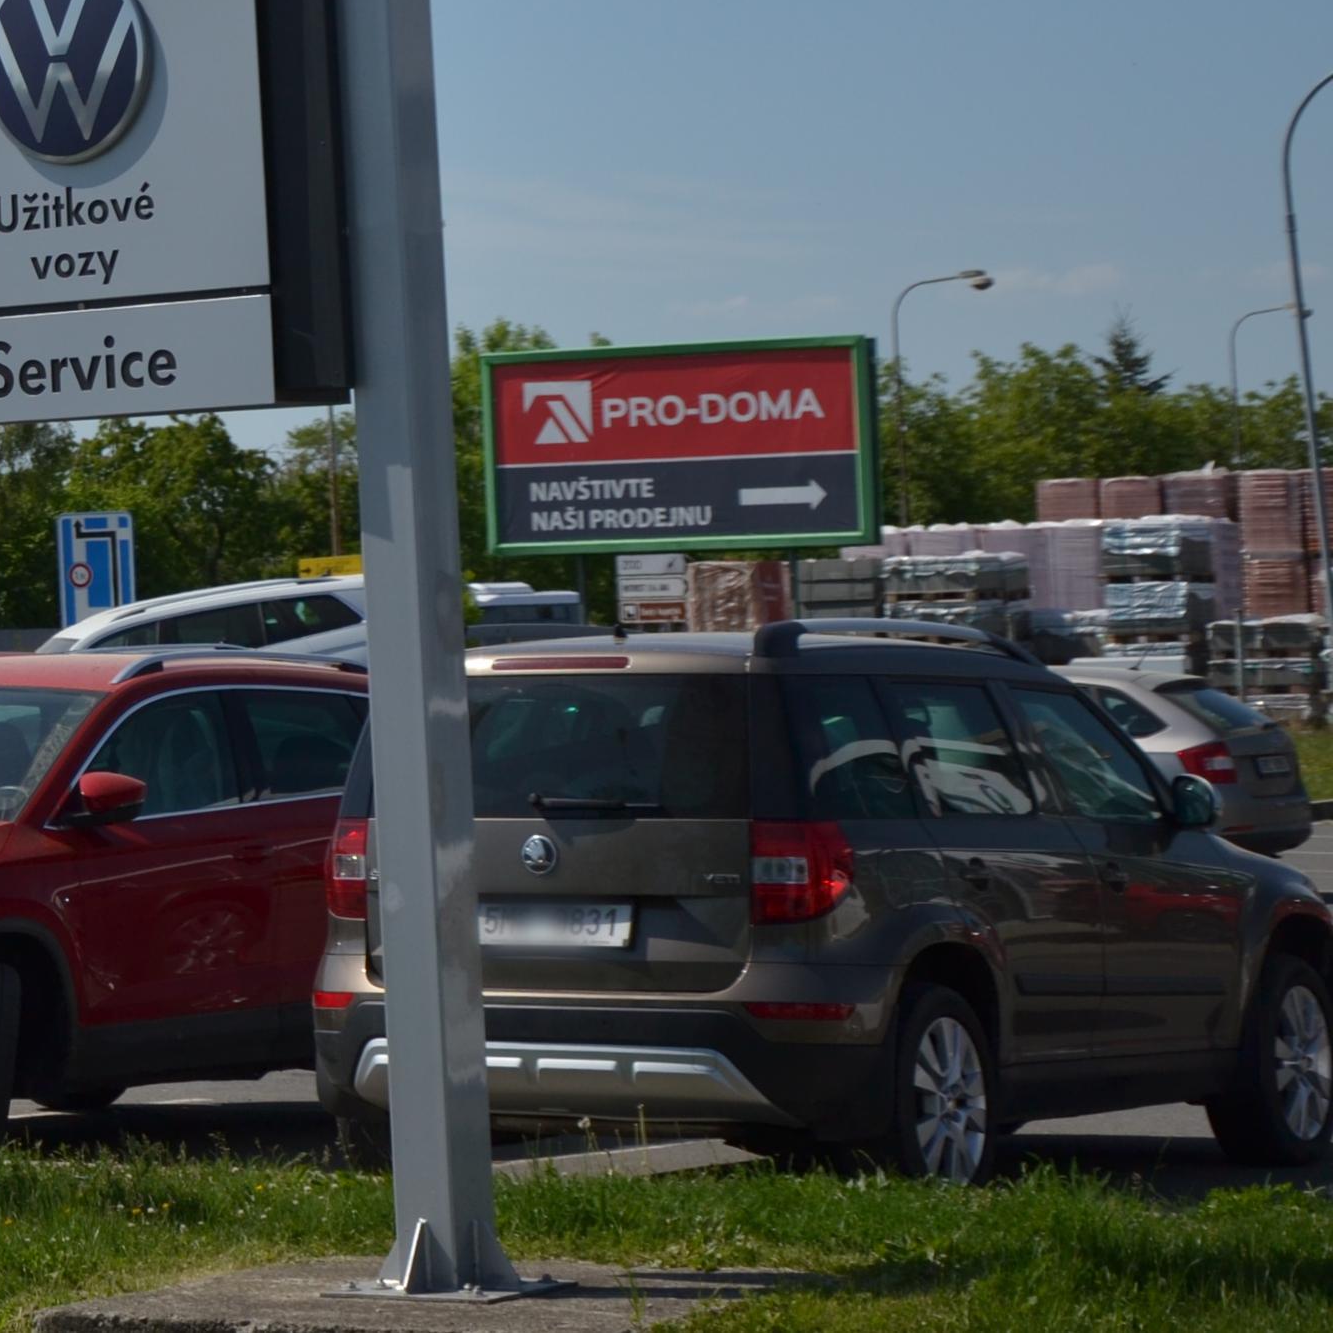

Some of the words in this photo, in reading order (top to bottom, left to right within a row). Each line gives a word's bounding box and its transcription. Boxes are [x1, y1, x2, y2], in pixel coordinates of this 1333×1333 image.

[30, 248, 119, 285] vozy
[601, 388, 826, 428] PRO-DOMA
[530, 476, 655, 503] NAVŠTIVTE
[531, 508, 585, 531] NAŠI
[589, 506, 713, 530] PRODEJNU
